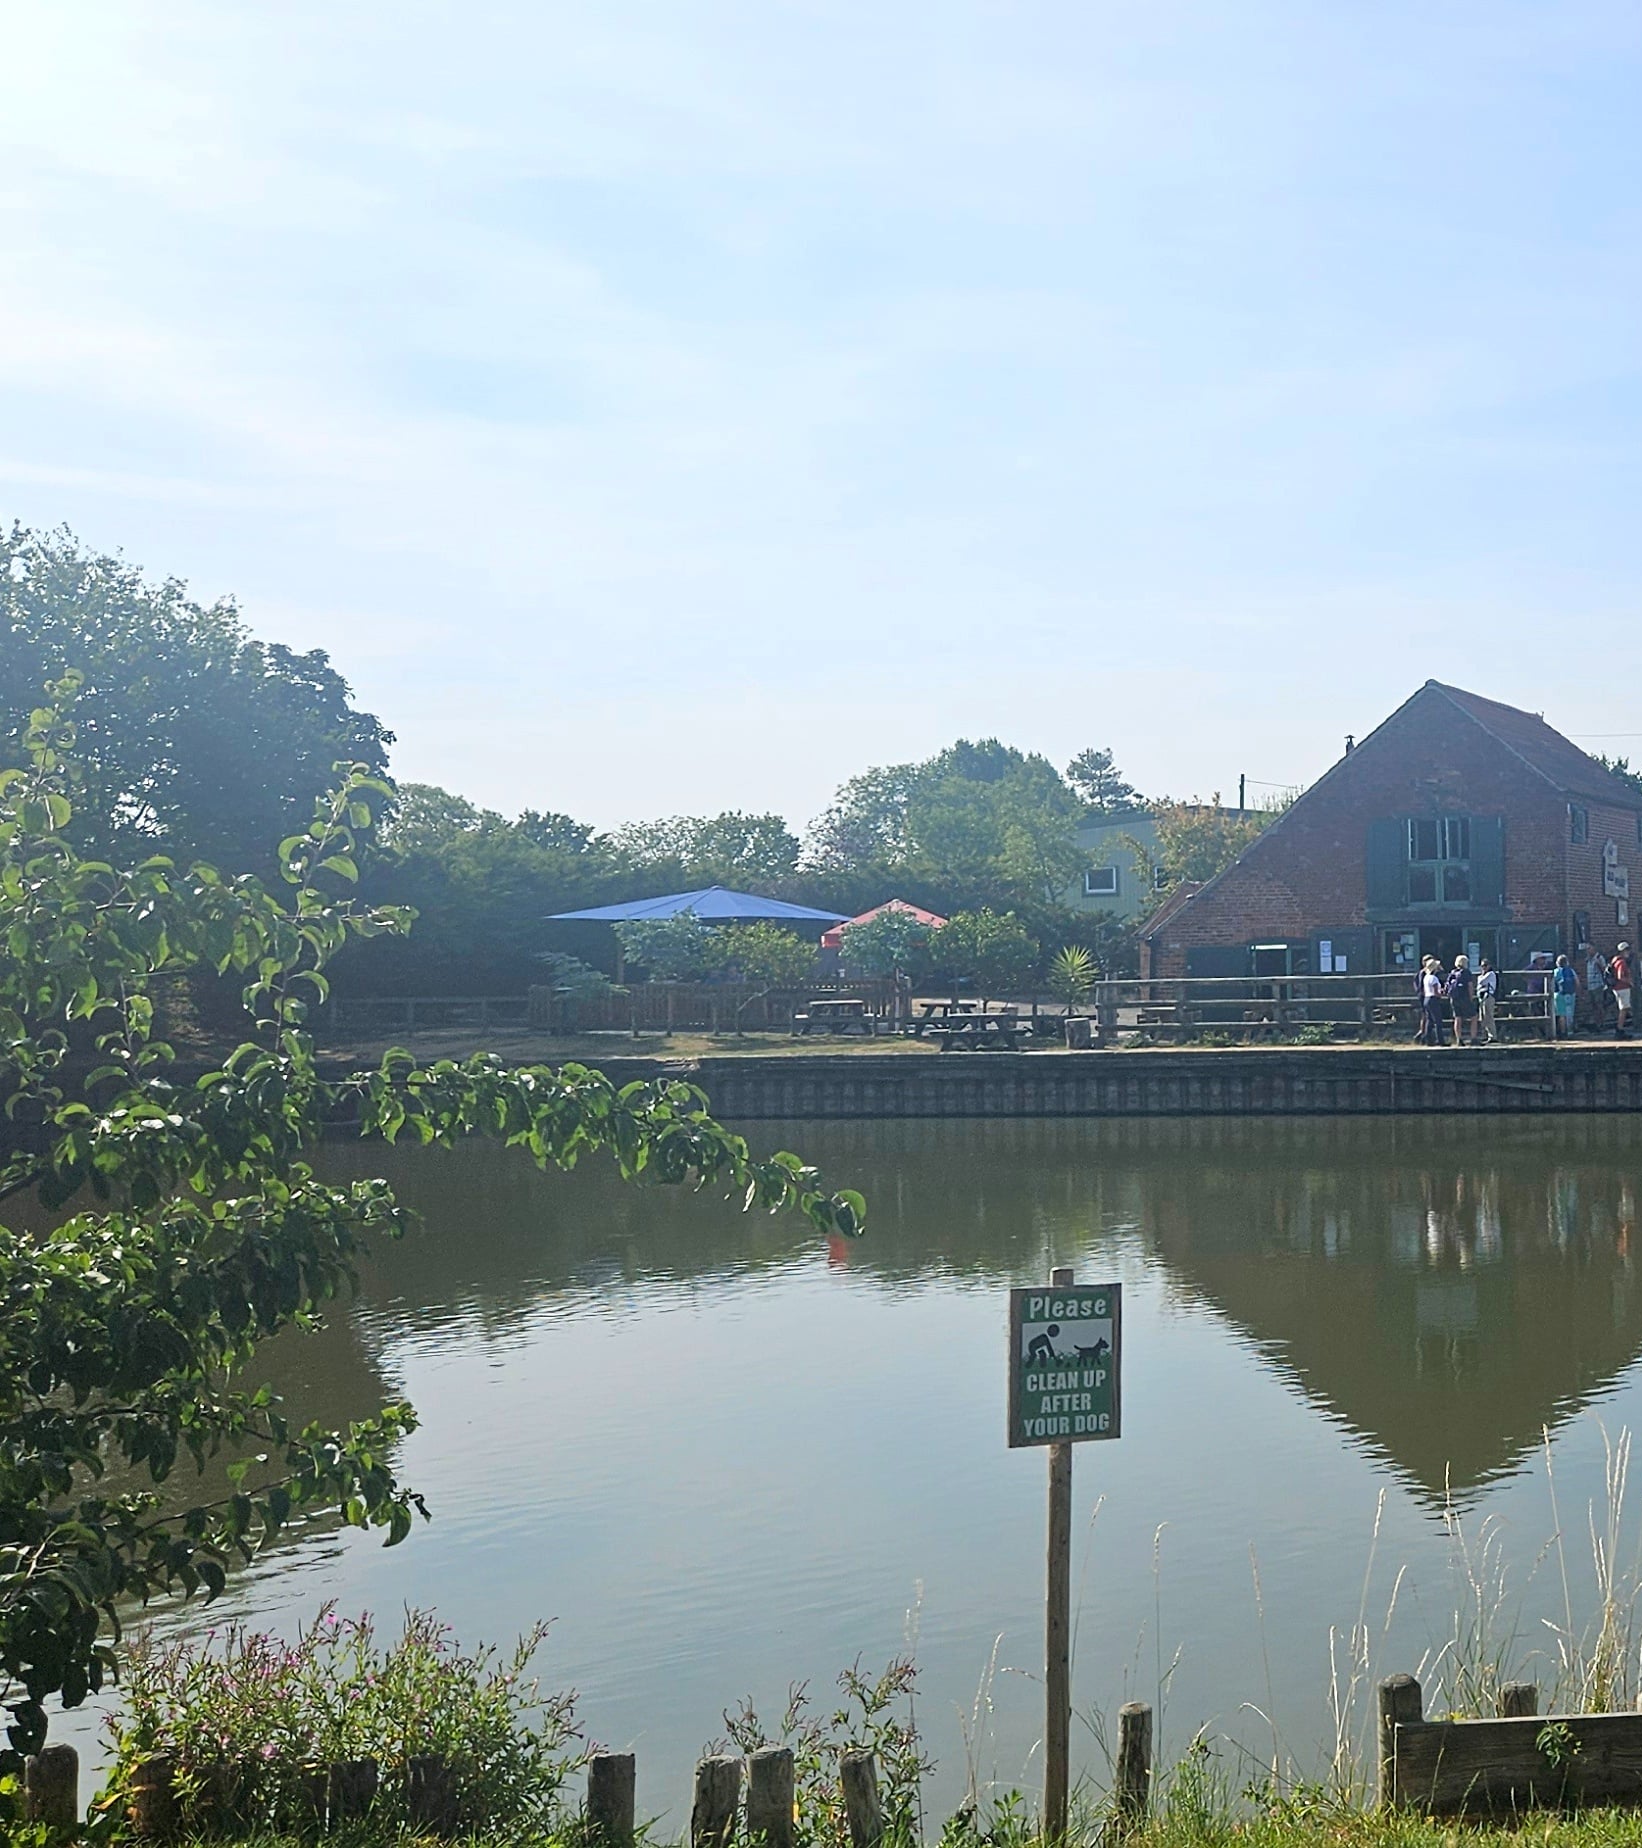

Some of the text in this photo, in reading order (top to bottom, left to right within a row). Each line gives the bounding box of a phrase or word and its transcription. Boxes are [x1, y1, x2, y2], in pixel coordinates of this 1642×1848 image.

[1029, 1297, 1107, 1319] Please
[1026, 1369, 1107, 1392] CLEAN UP
[1040, 1393, 1092, 1414] AFTER
[1023, 1413, 1110, 1438] YOUR DOG
